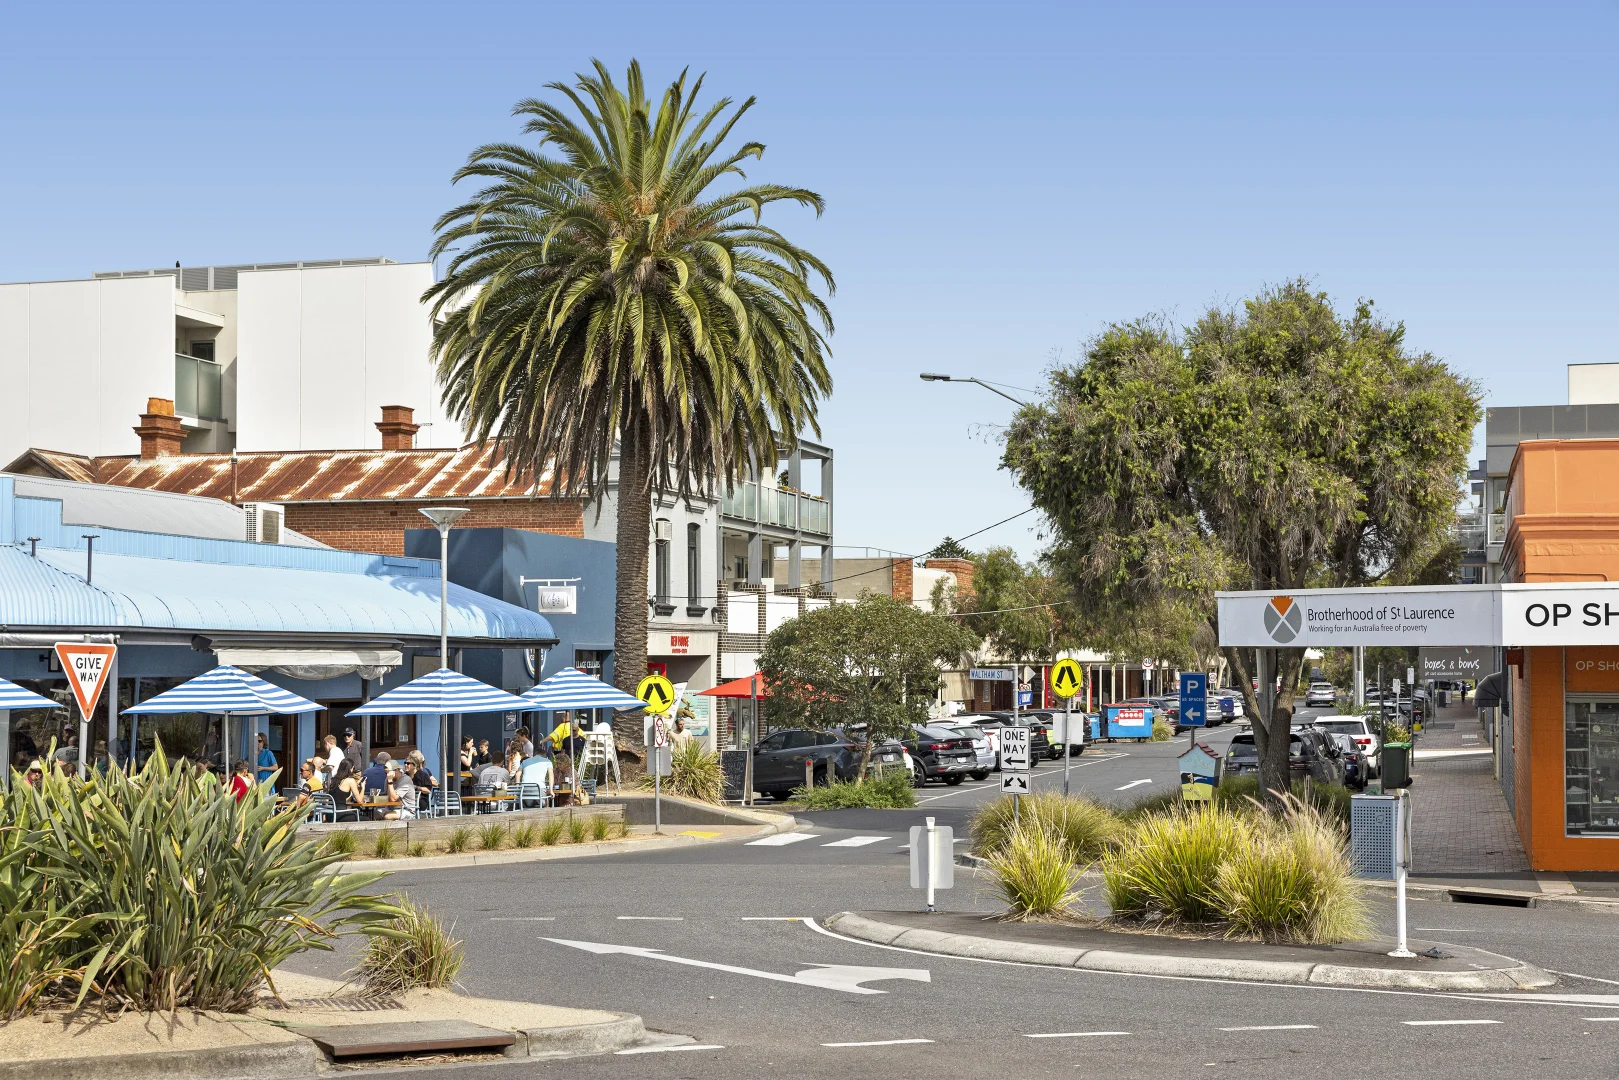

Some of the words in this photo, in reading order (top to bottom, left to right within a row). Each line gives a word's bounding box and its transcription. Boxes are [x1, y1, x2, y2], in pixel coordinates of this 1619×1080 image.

[1307, 607, 1374, 621] Brotherhood
[1376, 607, 1387, 620] of
[1390, 606, 1402, 620] St
[1403, 606, 1455, 620] Laurence
[1525, 602, 1572, 627] OP
[1582, 602, 1619, 627] SH
[1308, 624, 1334, 634] Working
[1334, 624, 1343, 633] for
[1352, 624, 1380, 632] Australia
[1380, 624, 1394, 632] free
[1395, 624, 1402, 632] of
[1402, 624, 1428, 633] poverty
[75, 657, 102, 670] GIVE
[1424, 656, 1446, 670] boxes
[1449, 660, 1455, 669] &
[1458, 656, 1480, 670] bows
[1575, 660, 1594, 671] OP
[80, 672, 99, 682] WAY
[970, 670, 996, 679] WALTHAM
[996, 670, 1004, 679] ST
[1186, 680, 1199, 694] P
[1004, 731, 1026, 742] ONE
[1003, 743, 1027, 755] WAY
